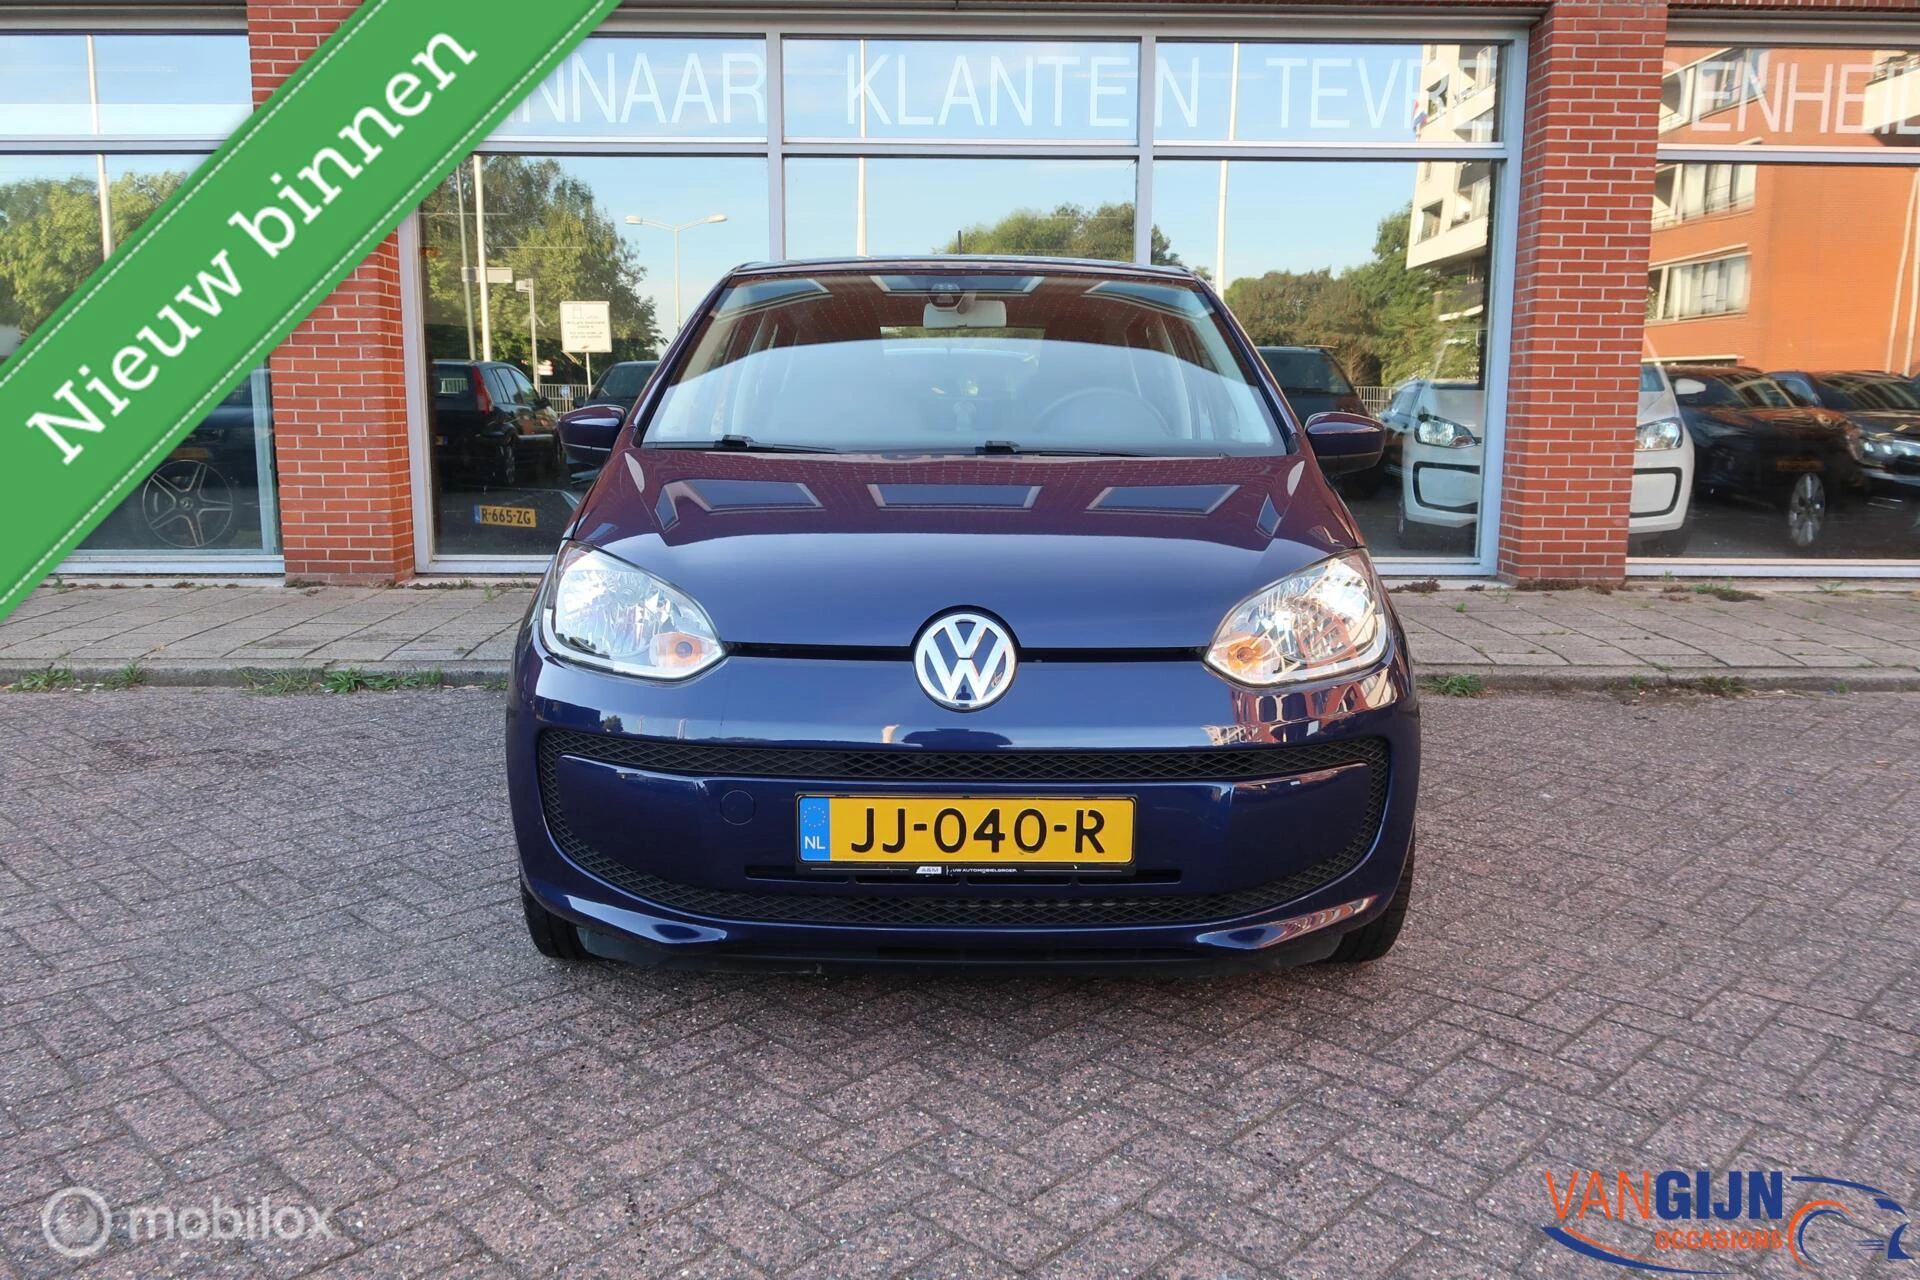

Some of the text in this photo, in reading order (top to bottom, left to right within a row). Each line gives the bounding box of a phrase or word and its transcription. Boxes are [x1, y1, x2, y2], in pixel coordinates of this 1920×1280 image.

[847, 54, 1200, 128] KLANTEN
[481, 508, 531, 525] R-665-ZG
[804, 835, 826, 849] NL
[850, 807, 1106, 854] JJ-040-R
